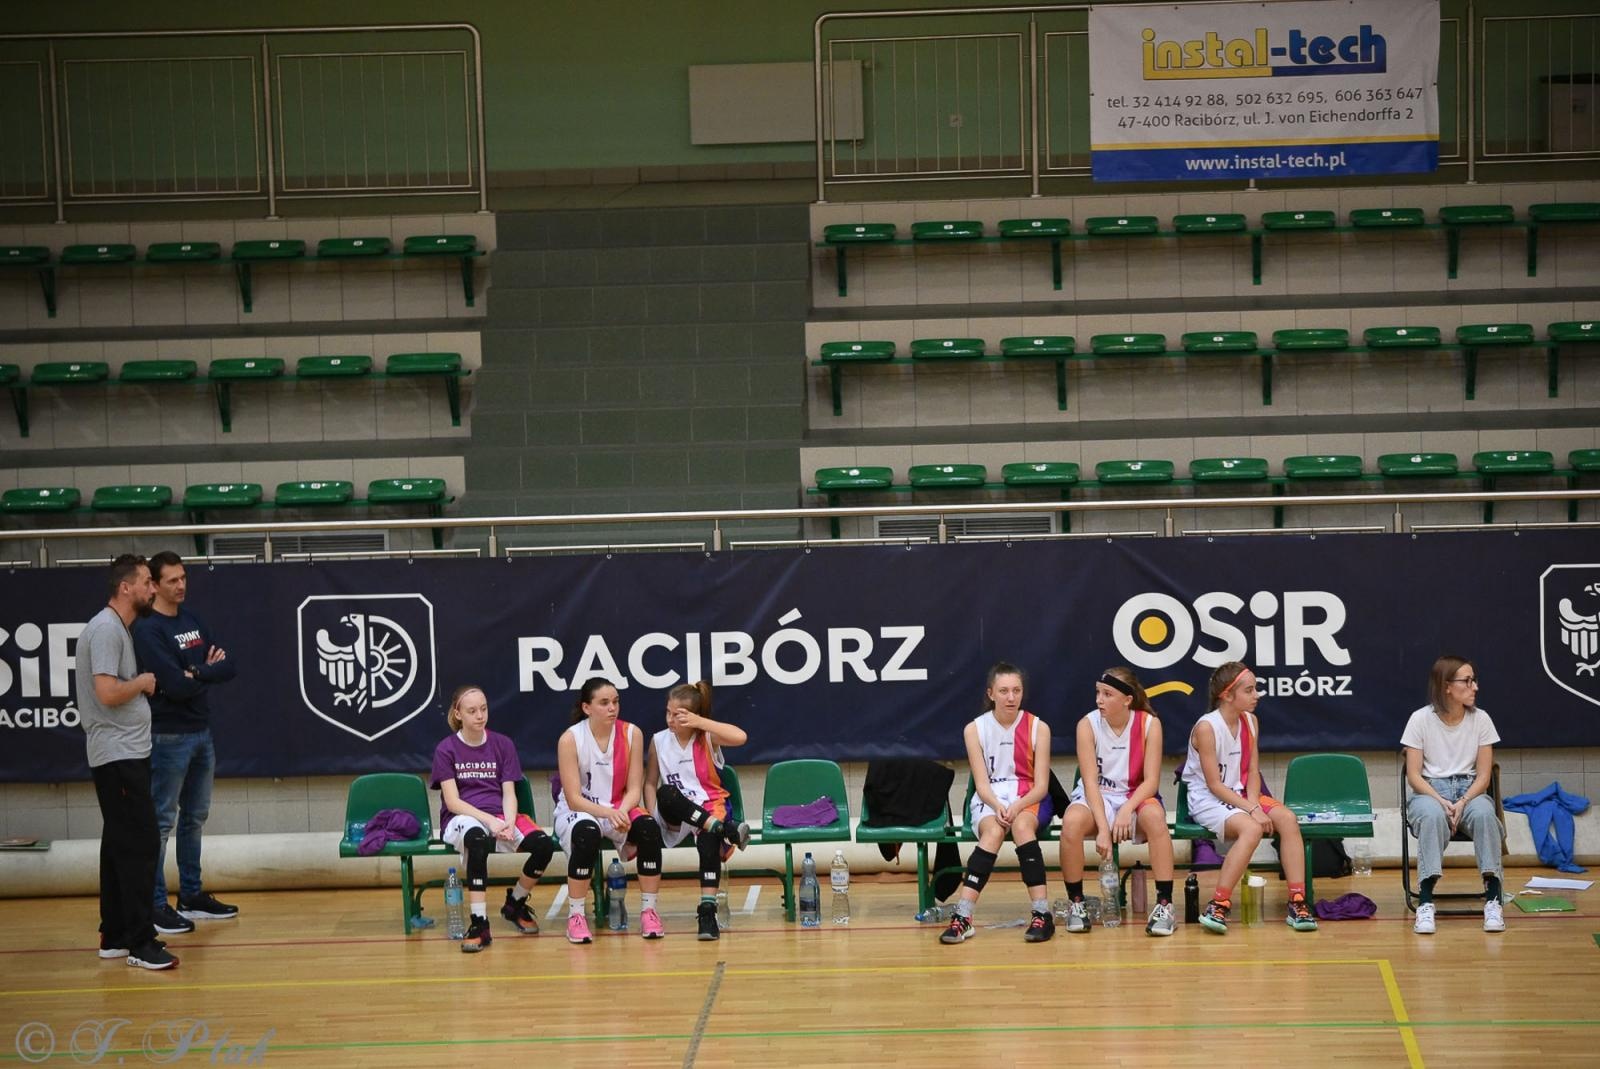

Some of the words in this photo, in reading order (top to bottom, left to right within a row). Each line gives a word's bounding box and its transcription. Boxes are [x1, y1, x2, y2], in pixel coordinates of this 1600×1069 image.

[1142, 25, 1386, 80] instal-tech
[1107, 95, 1129, 109] tel.
[1132, 96, 1150, 109] 32
[1154, 95, 1181, 108] 414
[1185, 95, 1202, 107] 92
[1206, 94, 1228, 107] 88,
[1235, 93, 1262, 106] 502
[1266, 92, 1293, 105] 632
[1335, 89, 1362, 102] 606
[1366, 88, 1393, 102] 363
[1396, 87, 1423, 100] 647
[1117, 115, 1171, 129] 47-400
[1174, 113, 1240, 127] Racibórz,
[1243, 112, 1261, 125] ul.
[1264, 111, 1275, 125] J.
[1278, 112, 1305, 124] von
[1309, 107, 1401, 123] Eichendorffa
[1405, 108, 1414, 120] 2
[1185, 151, 1347, 171] www.instal-tech.pl
[1112, 591, 1352, 669] OSiR
[518, 608, 928, 692] RACIBÓRZ
[1255, 669, 1353, 696] CIBÓRZ
[0, 701, 80, 728] ACIBÓ
